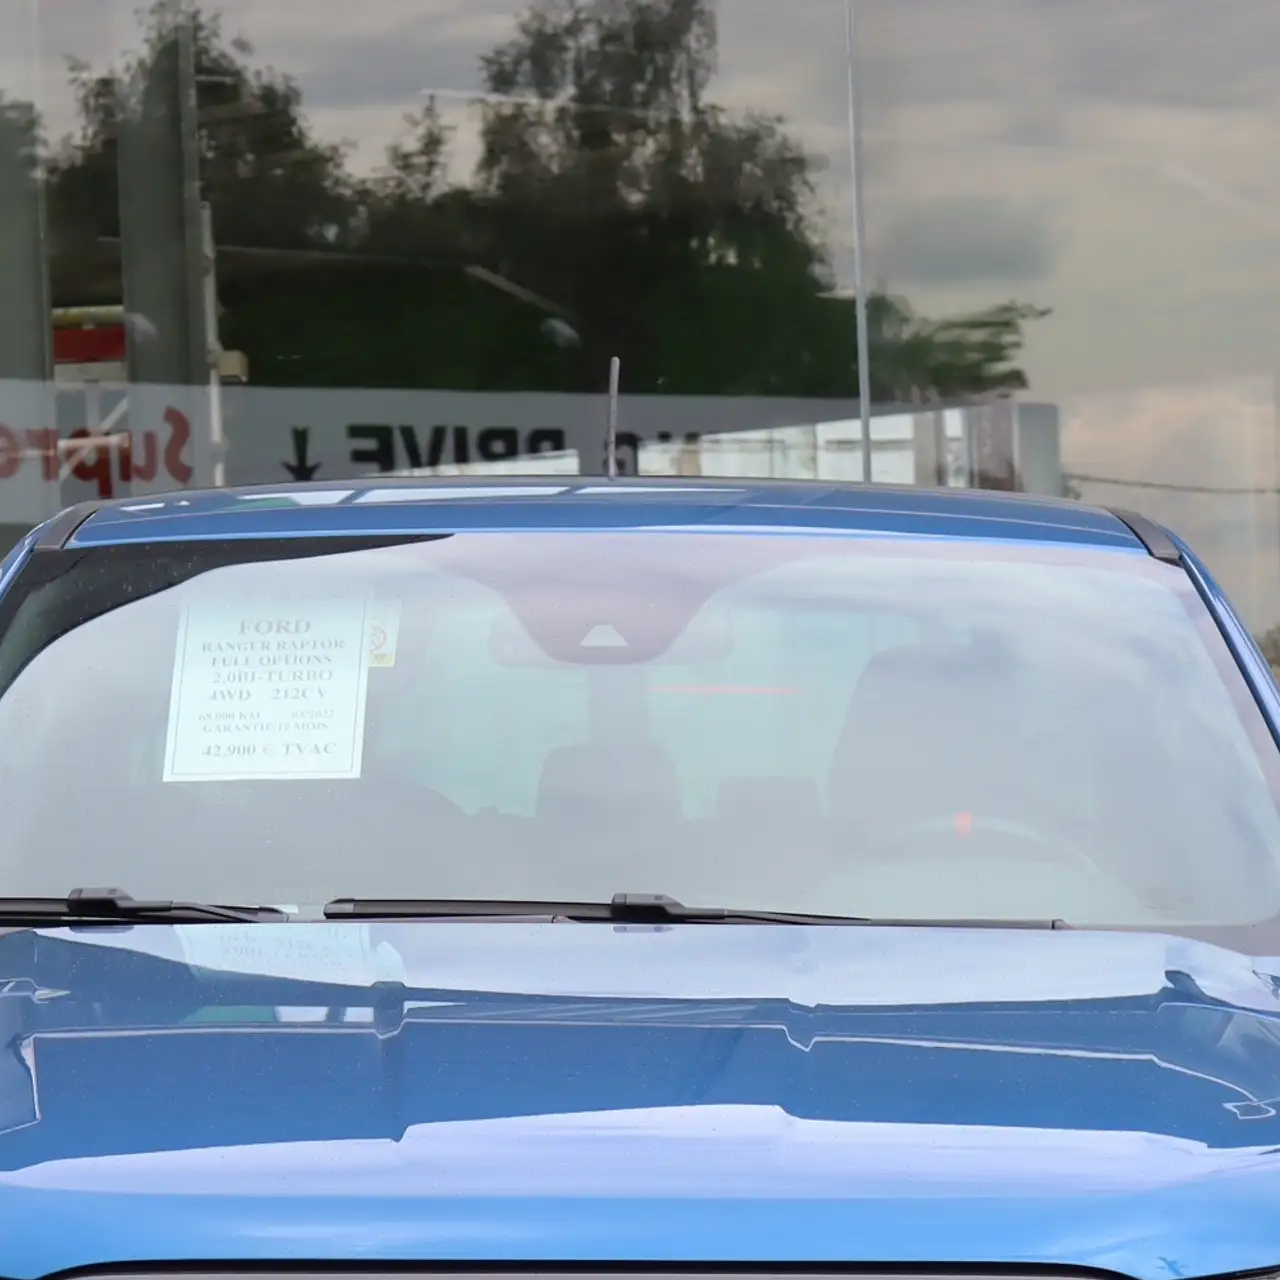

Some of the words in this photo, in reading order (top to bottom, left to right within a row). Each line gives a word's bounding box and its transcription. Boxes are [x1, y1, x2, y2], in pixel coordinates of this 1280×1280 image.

[239, 618, 312, 635] FORD
[201, 641, 273, 653] RANGER
[277, 638, 348, 652] RAPTOR
[281, 741, 338, 756] TVAC
